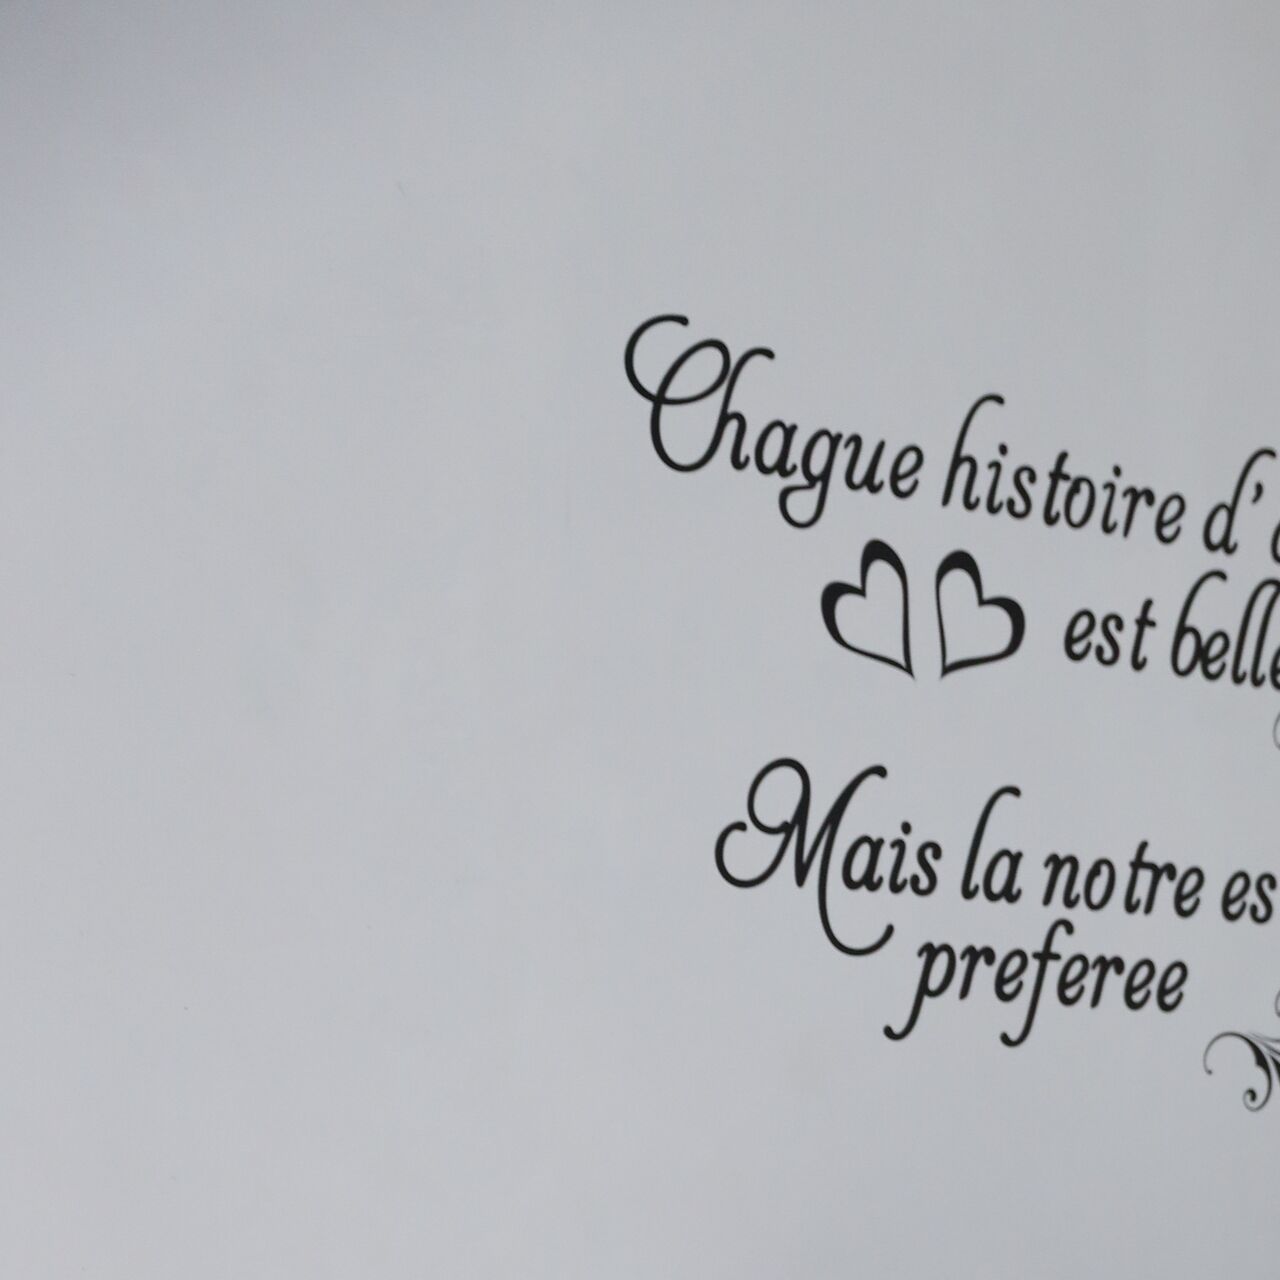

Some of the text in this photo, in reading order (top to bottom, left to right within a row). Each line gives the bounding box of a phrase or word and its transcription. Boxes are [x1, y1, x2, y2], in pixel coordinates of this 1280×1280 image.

[940, 392, 1187, 546] histoire
[1062, 597, 1158, 673] est
[713, 756, 944, 958] Mais
[960, 784, 1025, 905] la
[1041, 839, 1206, 920] notre
[882, 917, 1190, 1049] preferee
